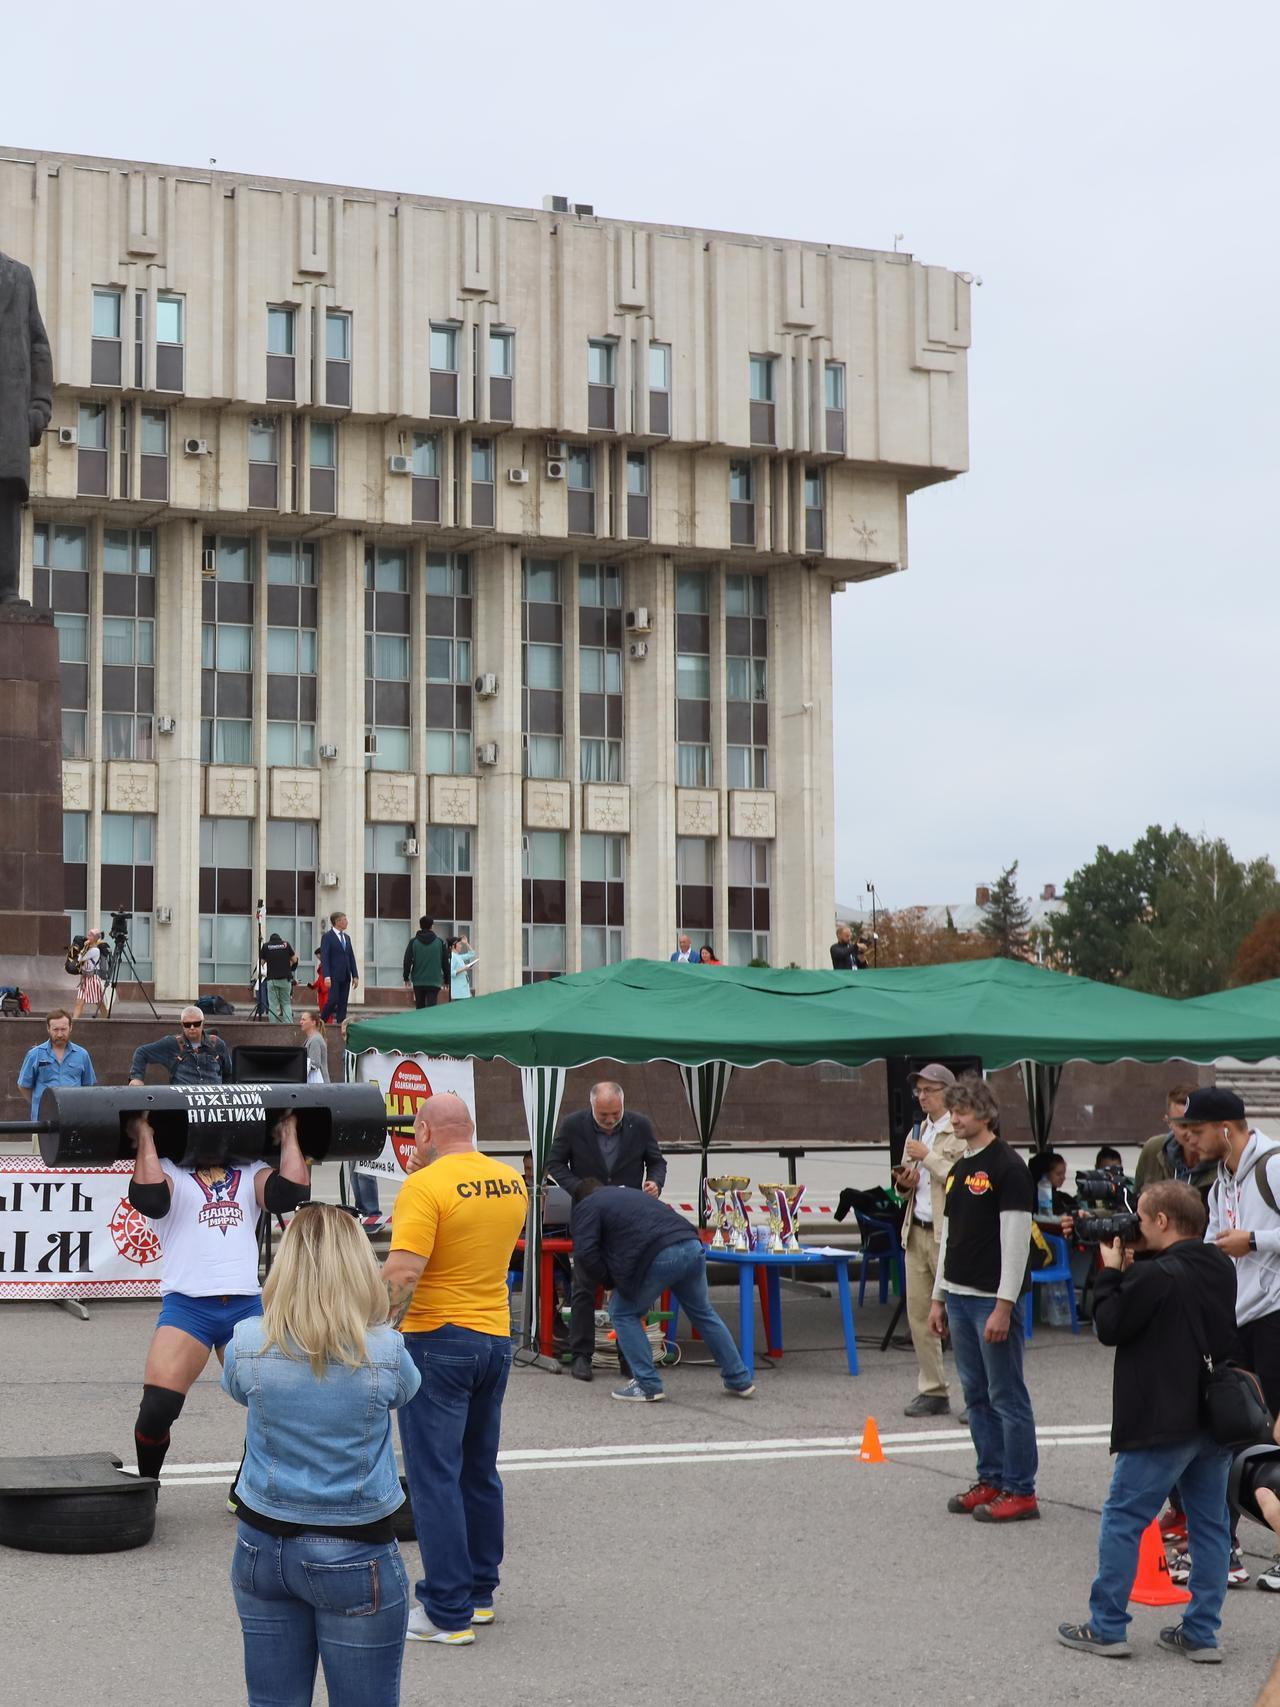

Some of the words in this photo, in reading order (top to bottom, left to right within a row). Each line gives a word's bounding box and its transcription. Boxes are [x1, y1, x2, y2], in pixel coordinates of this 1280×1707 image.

[185, 1092, 263, 1106] ТЯЖЁЛОЙ
[187, 1107, 267, 1123] АТЛЕТИКИ
[399, 1144, 416, 1156] ФИТ
[456, 1178, 523, 1198] СУДЬЯ
[199, 1207, 243, 1222] НАЦИЯ
[209, 1217, 237, 1226] МИРА
